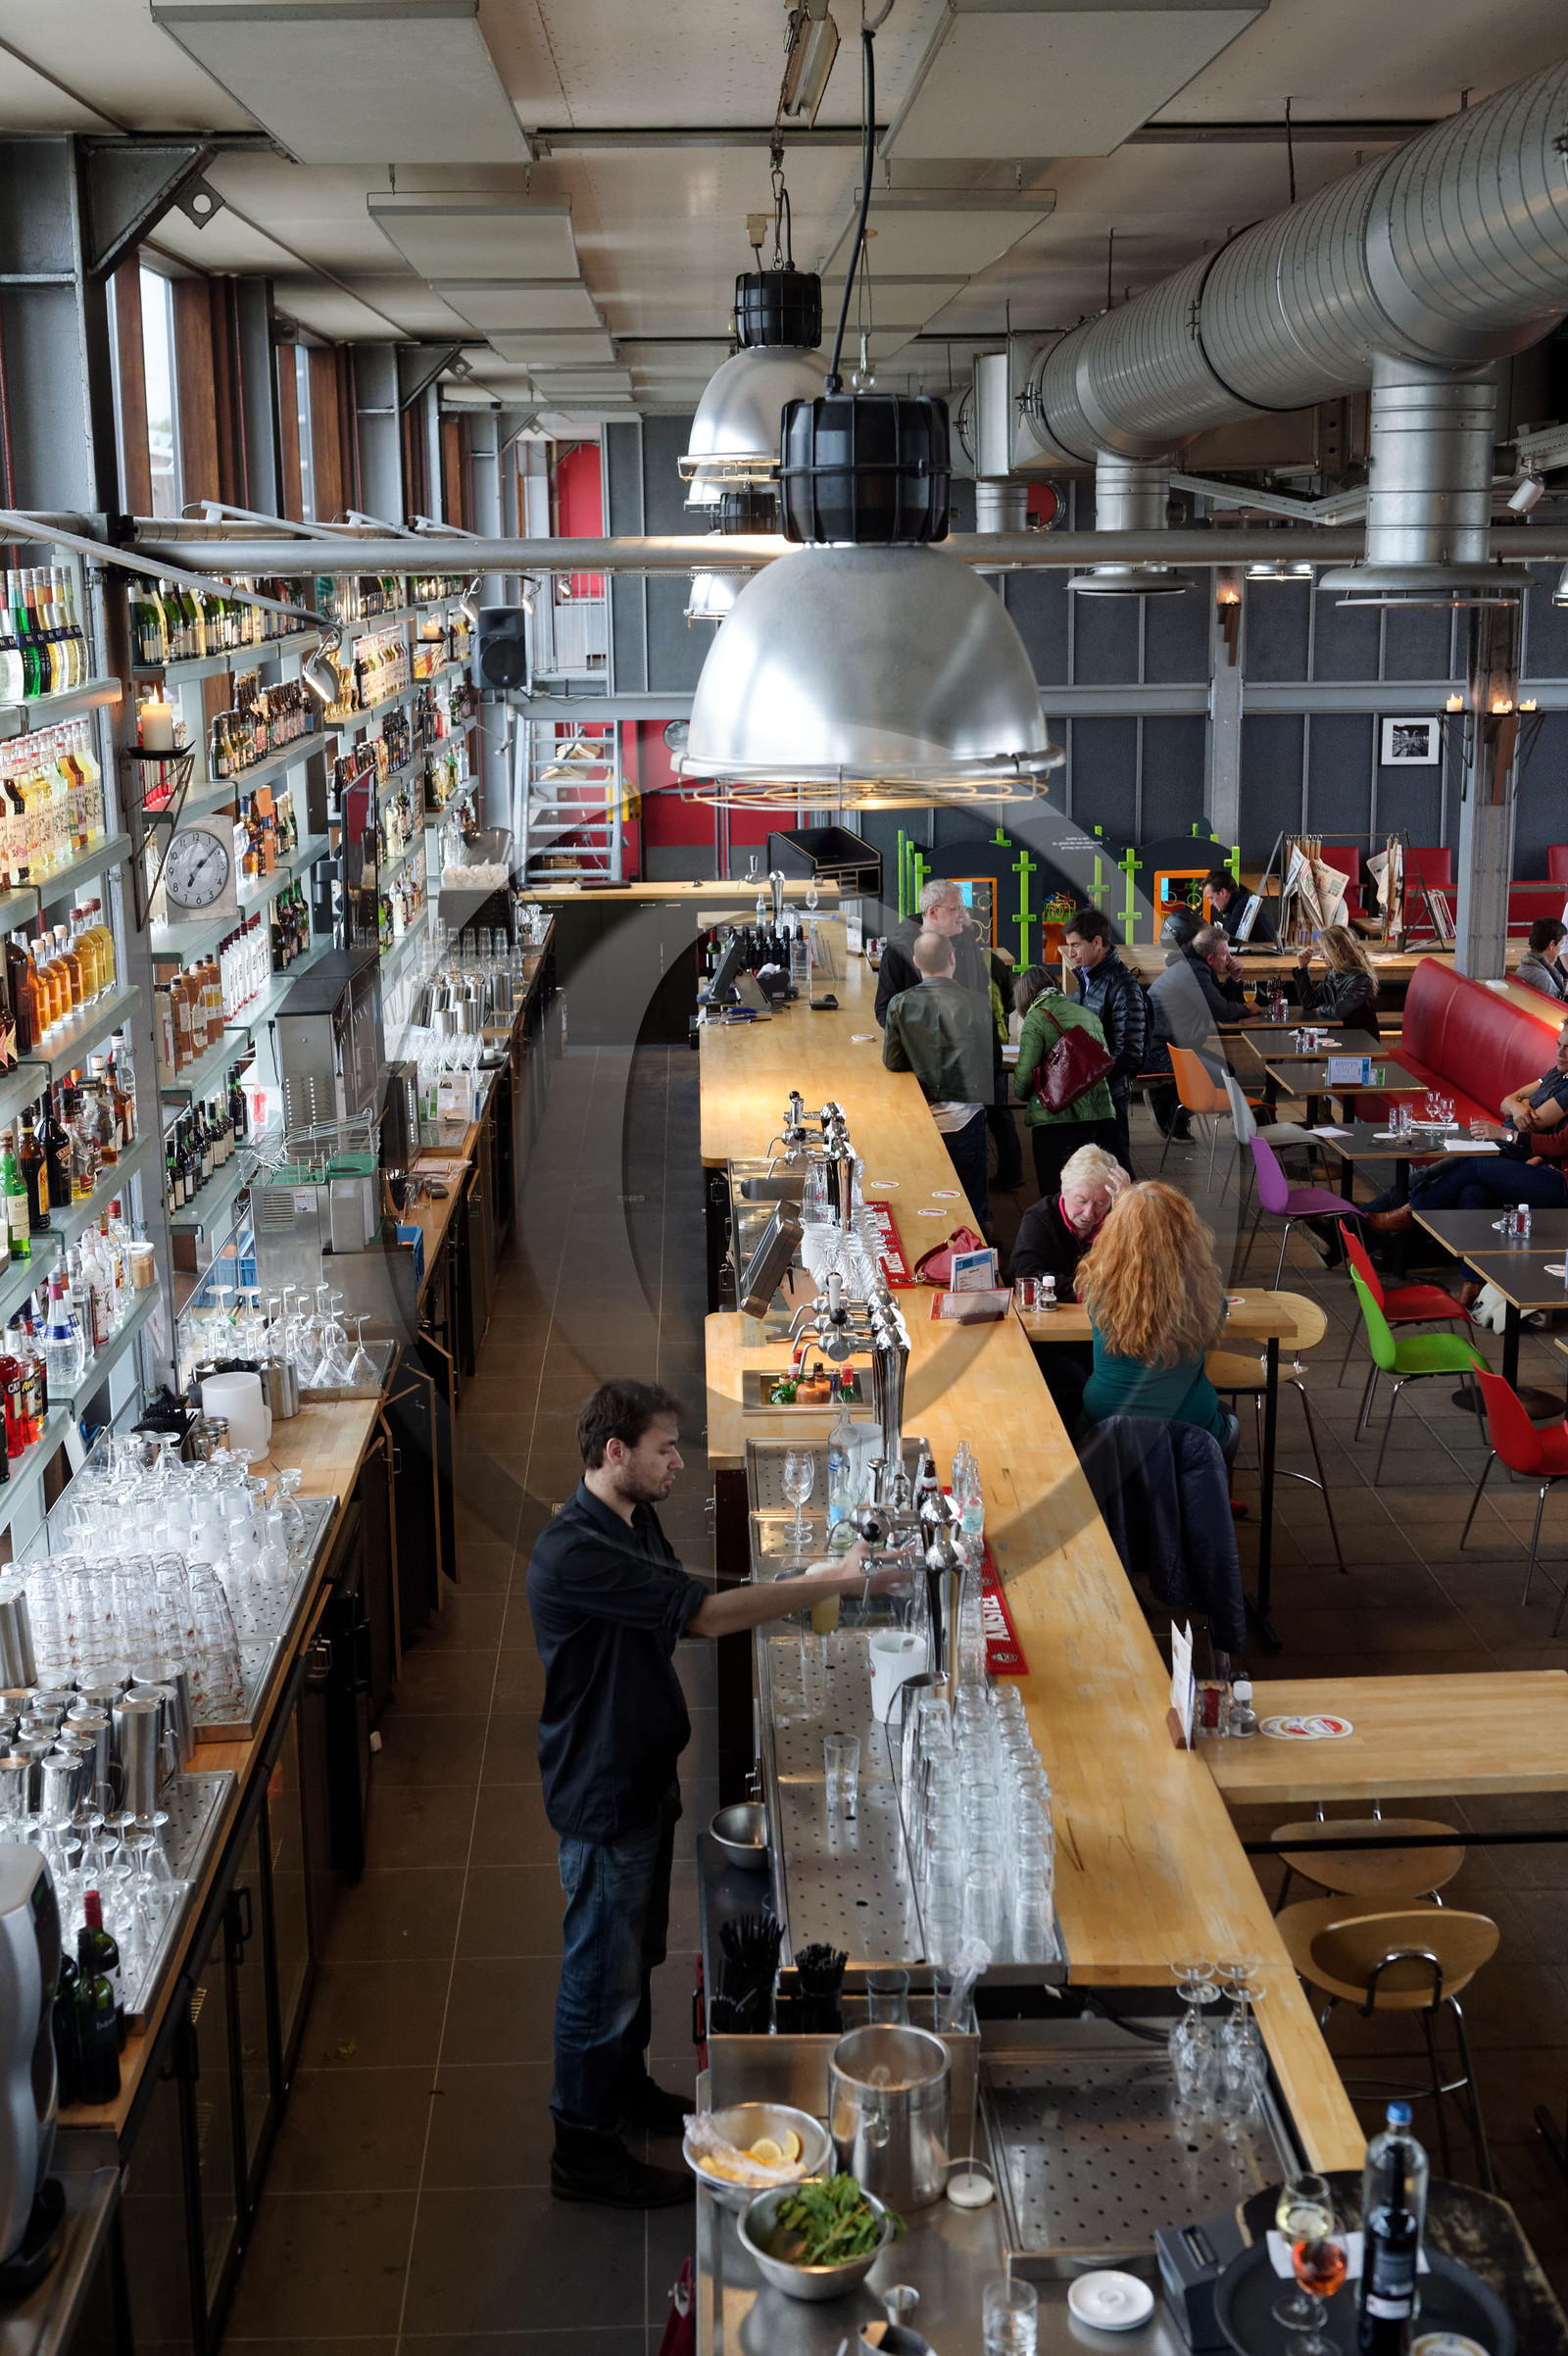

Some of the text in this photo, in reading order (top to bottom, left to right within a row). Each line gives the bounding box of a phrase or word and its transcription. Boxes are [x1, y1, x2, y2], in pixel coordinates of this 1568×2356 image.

[192, 832, 200, 842] 12
[168, 866, 174, 876] 9
[217, 877, 222, 886] 4
[172, 882, 178, 892] 8
[196, 895, 202, 905] 6
[209, 891, 215, 900] 5
[884, 1252, 906, 1274] AMSTEL
[982, 1594, 1011, 1642] AMSTEL
